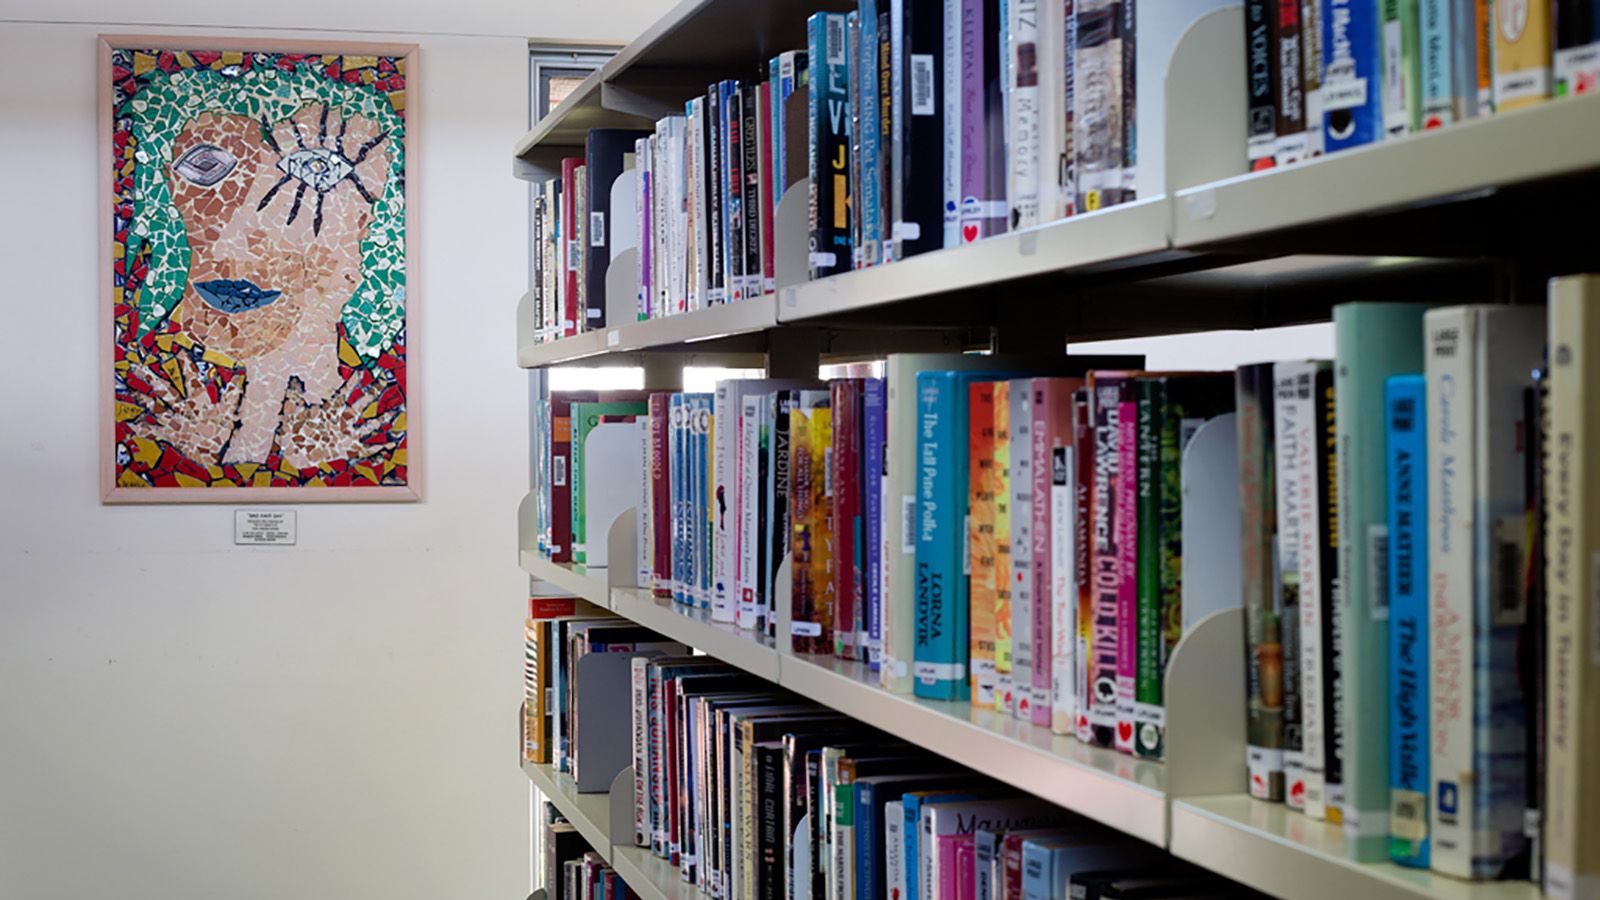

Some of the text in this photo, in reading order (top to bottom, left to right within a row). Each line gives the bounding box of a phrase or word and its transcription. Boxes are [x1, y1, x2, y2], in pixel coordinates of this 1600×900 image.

[864, 96, 874, 134] KING
[864, 139, 875, 163] Pet
[776, 429, 791, 499] JARDINE
[1107, 409, 1119, 474] DAVID
[1140, 399, 1151, 497] LANTERN
[1300, 426, 1312, 522] VALERIE
[1555, 433, 1572, 513] Every
[922, 412, 939, 542] The Tall Pine Polka
[1096, 426, 1109, 551] LAWRENCE
[1281, 405, 1299, 569] FAITH MARTIN
[1397, 448, 1413, 504] ANNE
[1098, 556, 1118, 617] COLD
[1302, 532, 1313, 627] MARTIN
[1396, 510, 1413, 597] MATHER
[1555, 526, 1572, 587] Day
[917, 562, 930, 647] LANDVIK
[930, 572, 943, 639] LORNA
[1556, 597, 1572, 624] in
[1096, 624, 1118, 673] KILL
[1398, 618, 1415, 662] The
[1396, 669, 1415, 728] High
[1554, 635, 1573, 750] Tuscany
[744, 815, 752, 861] WARS
